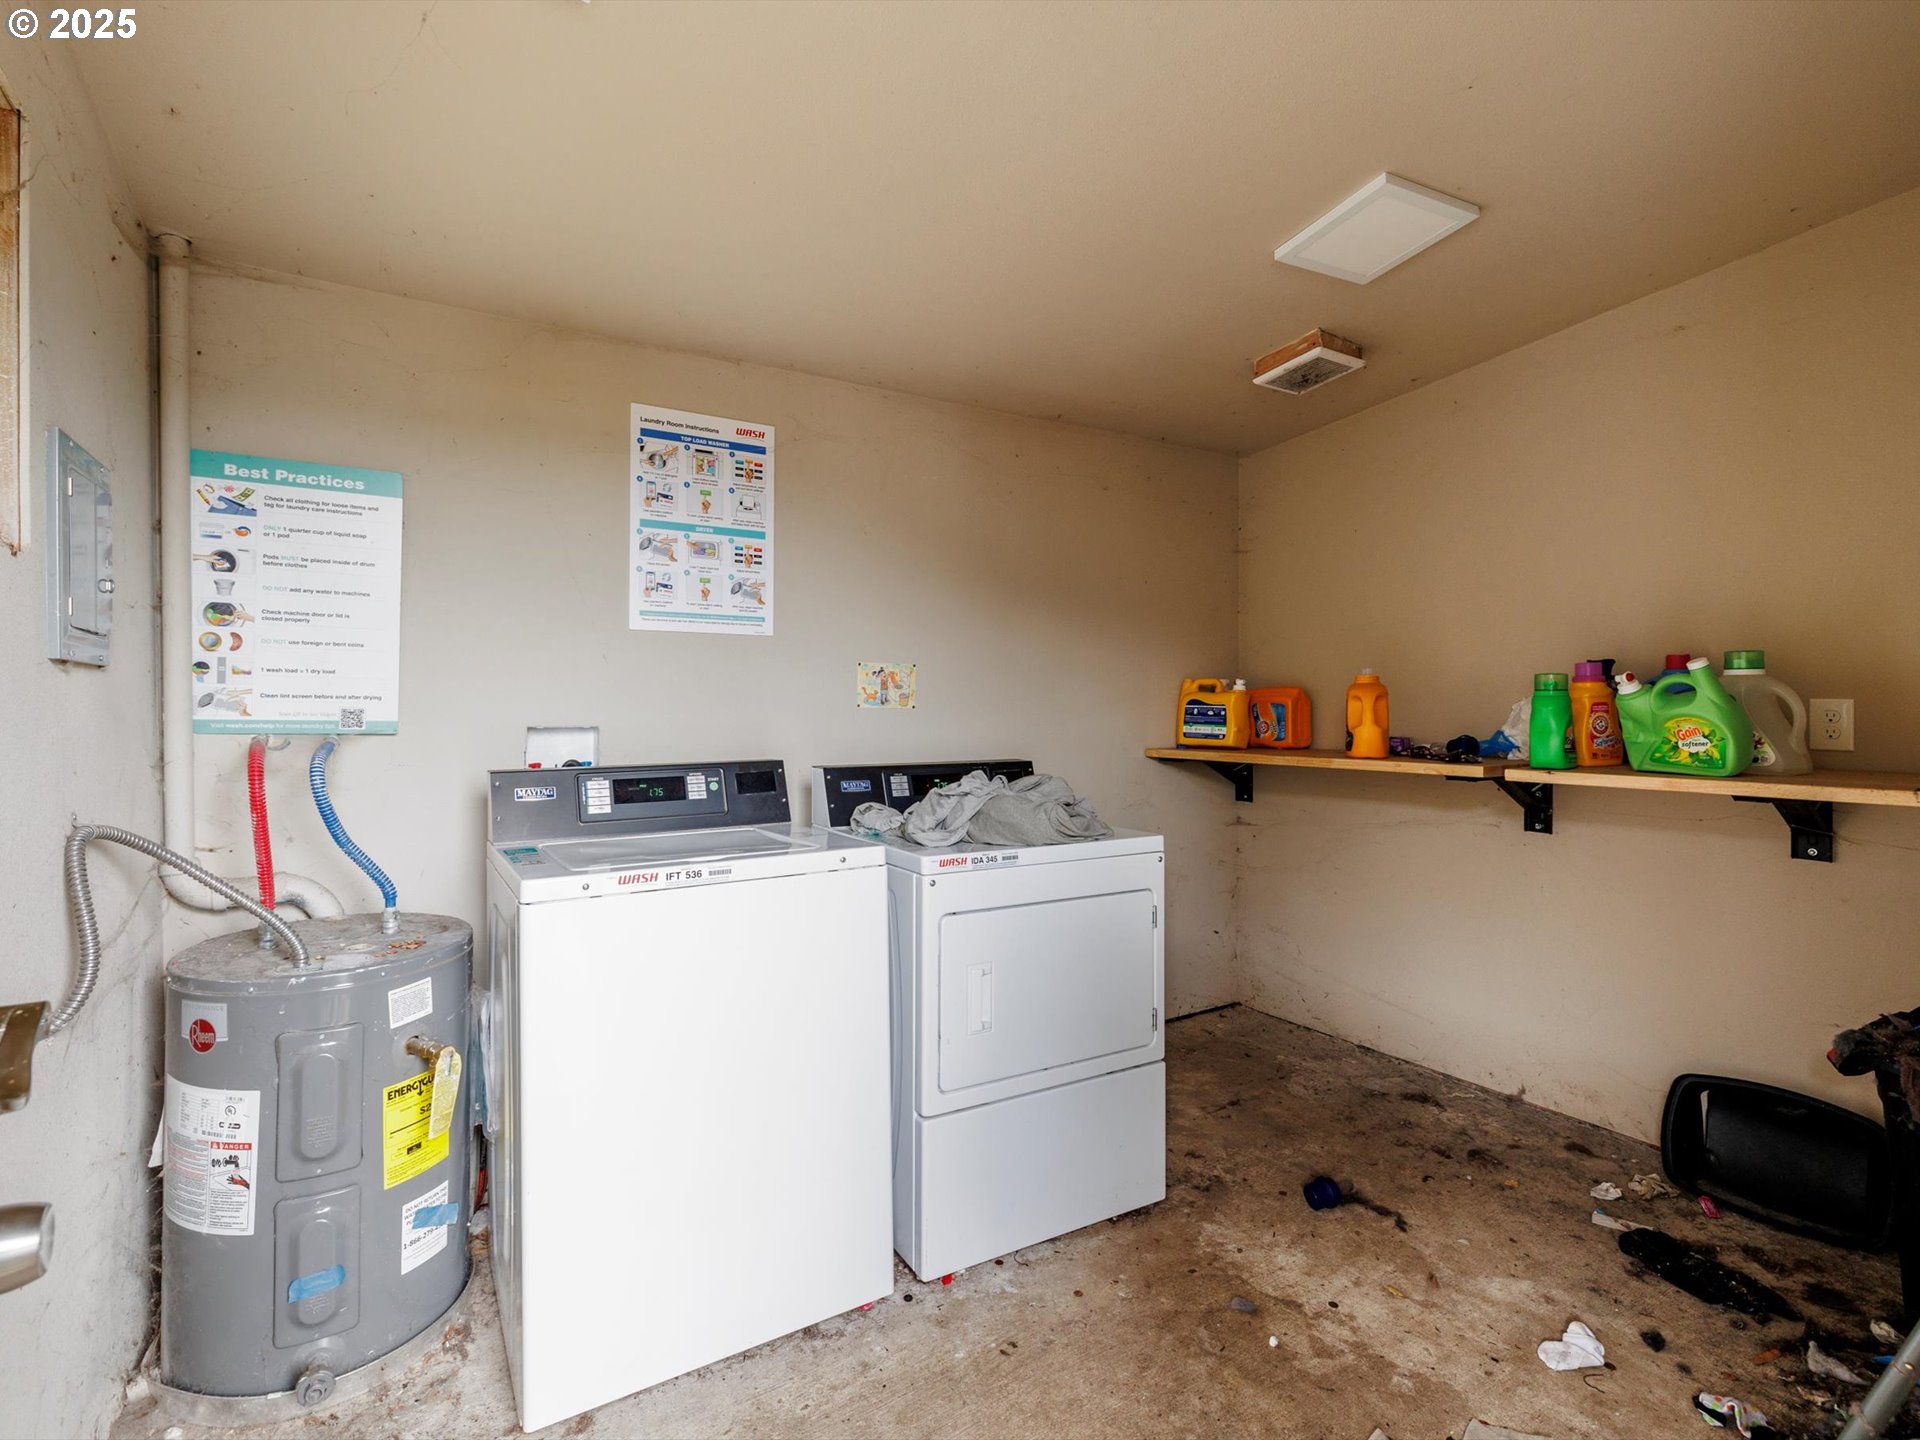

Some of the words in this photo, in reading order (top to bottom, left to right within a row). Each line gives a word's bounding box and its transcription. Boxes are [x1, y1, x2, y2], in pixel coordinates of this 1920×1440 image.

[640, 416, 665, 426] Laundry
[666, 419, 684, 428] Room
[685, 423, 719, 434] Instructions
[736, 427, 765, 439] WASH
[692, 437, 707, 445] LOAD
[707, 439, 730, 448] WASHER
[224, 463, 269, 480] Best
[275, 469, 365, 490] Practices
[286, 504, 309, 512] laundry
[326, 508, 363, 516] instructions
[1676, 727, 1701, 741] Gain
[1681, 741, 1708, 749] softener
[939, 857, 968, 868] WASH
[971, 857, 984, 865] IDA
[986, 855, 998, 863] 345
[618, 872, 659, 885] WASH
[666, 871, 681, 881] IFT
[685, 870, 702, 879] 536
